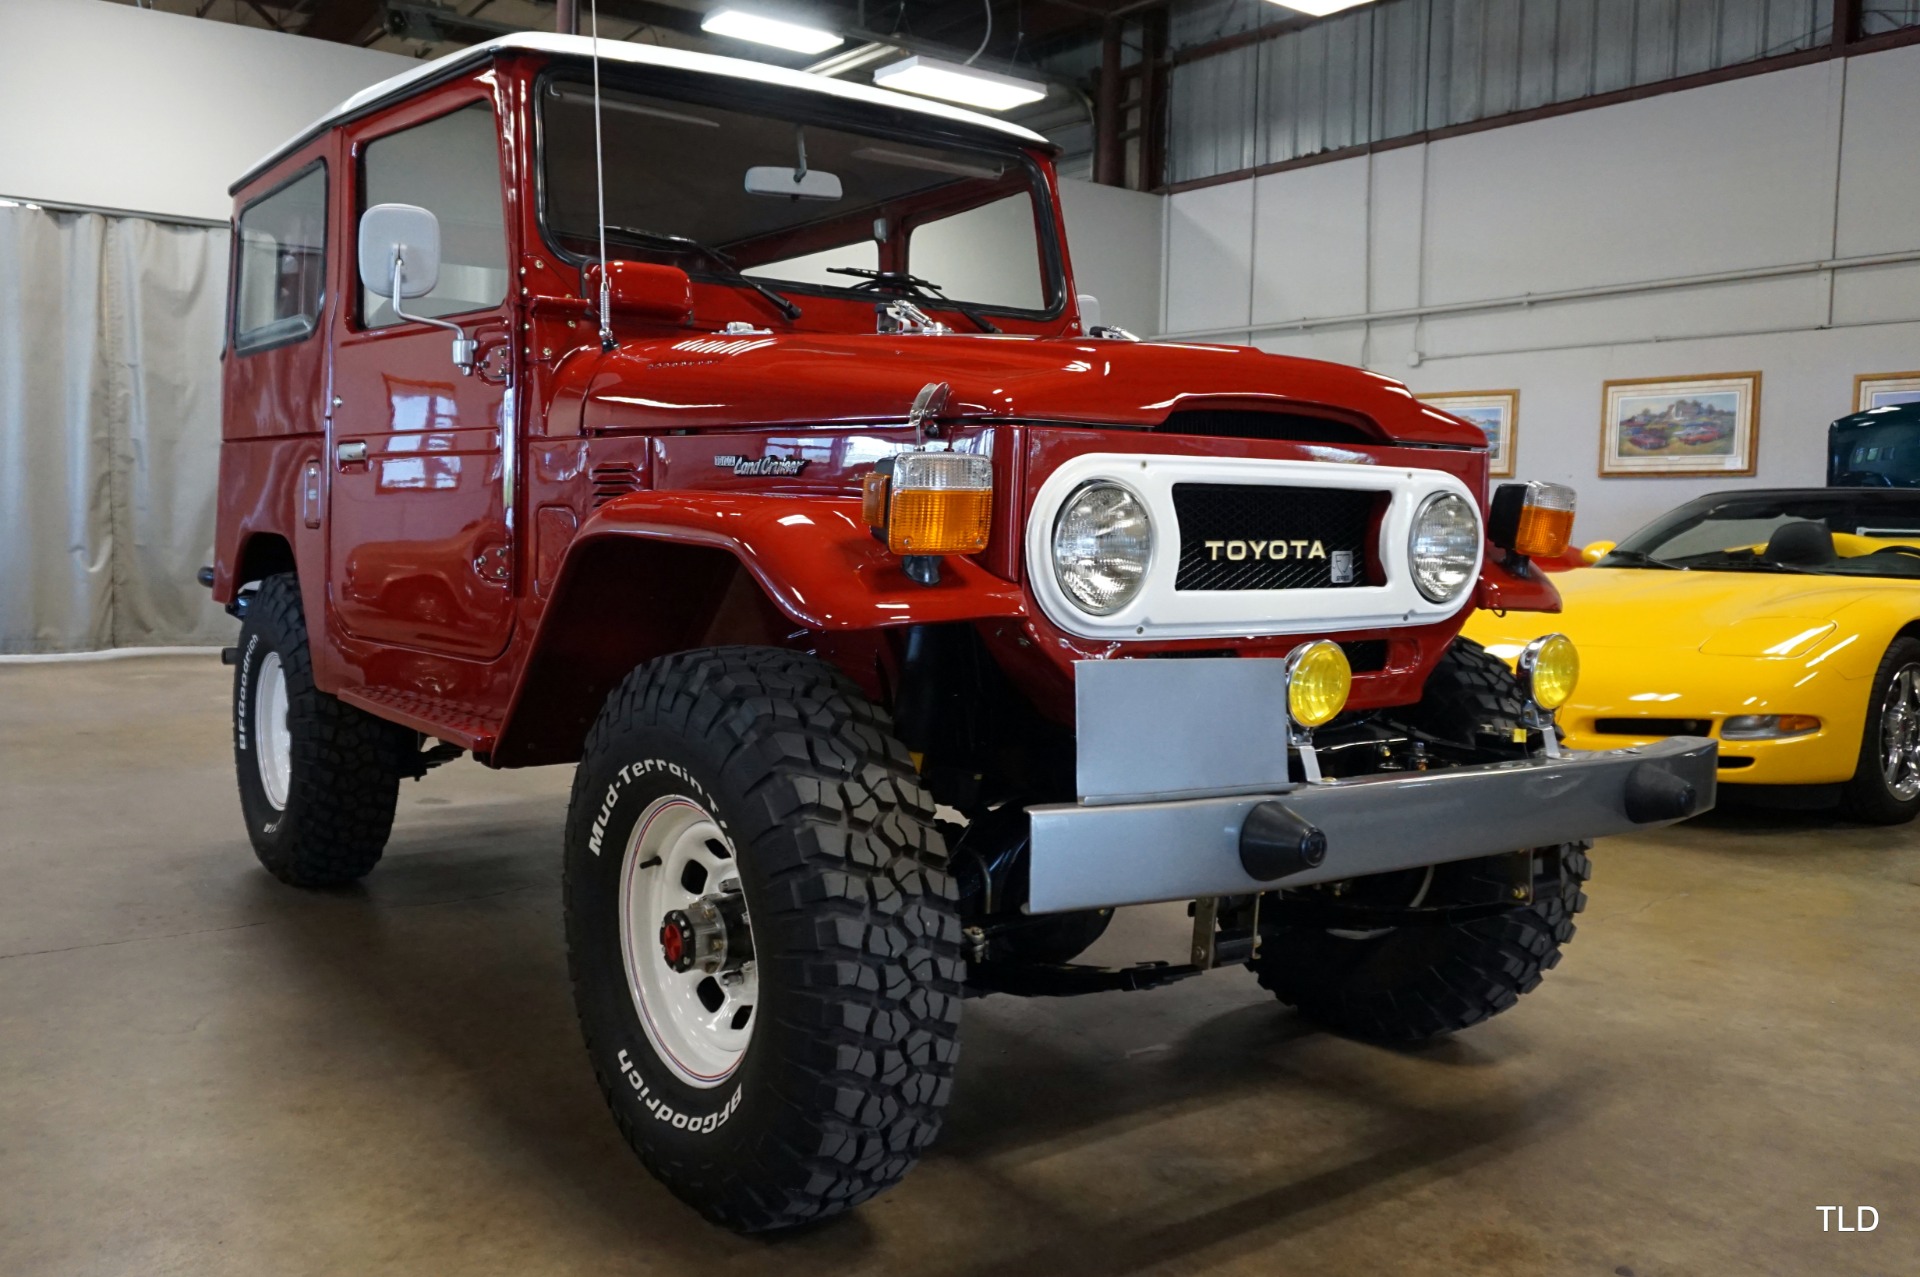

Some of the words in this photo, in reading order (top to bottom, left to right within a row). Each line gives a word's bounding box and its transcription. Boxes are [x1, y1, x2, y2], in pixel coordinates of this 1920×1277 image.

[733, 457, 761, 475] Land
[761, 457, 804, 475] Cruiser
[1205, 540, 1326, 560] TOYOTA
[239, 634, 259, 749] BFGoodrich
[588, 758, 703, 857] Mud-Terrain
[617, 1049, 742, 1134] BFGoodrich
